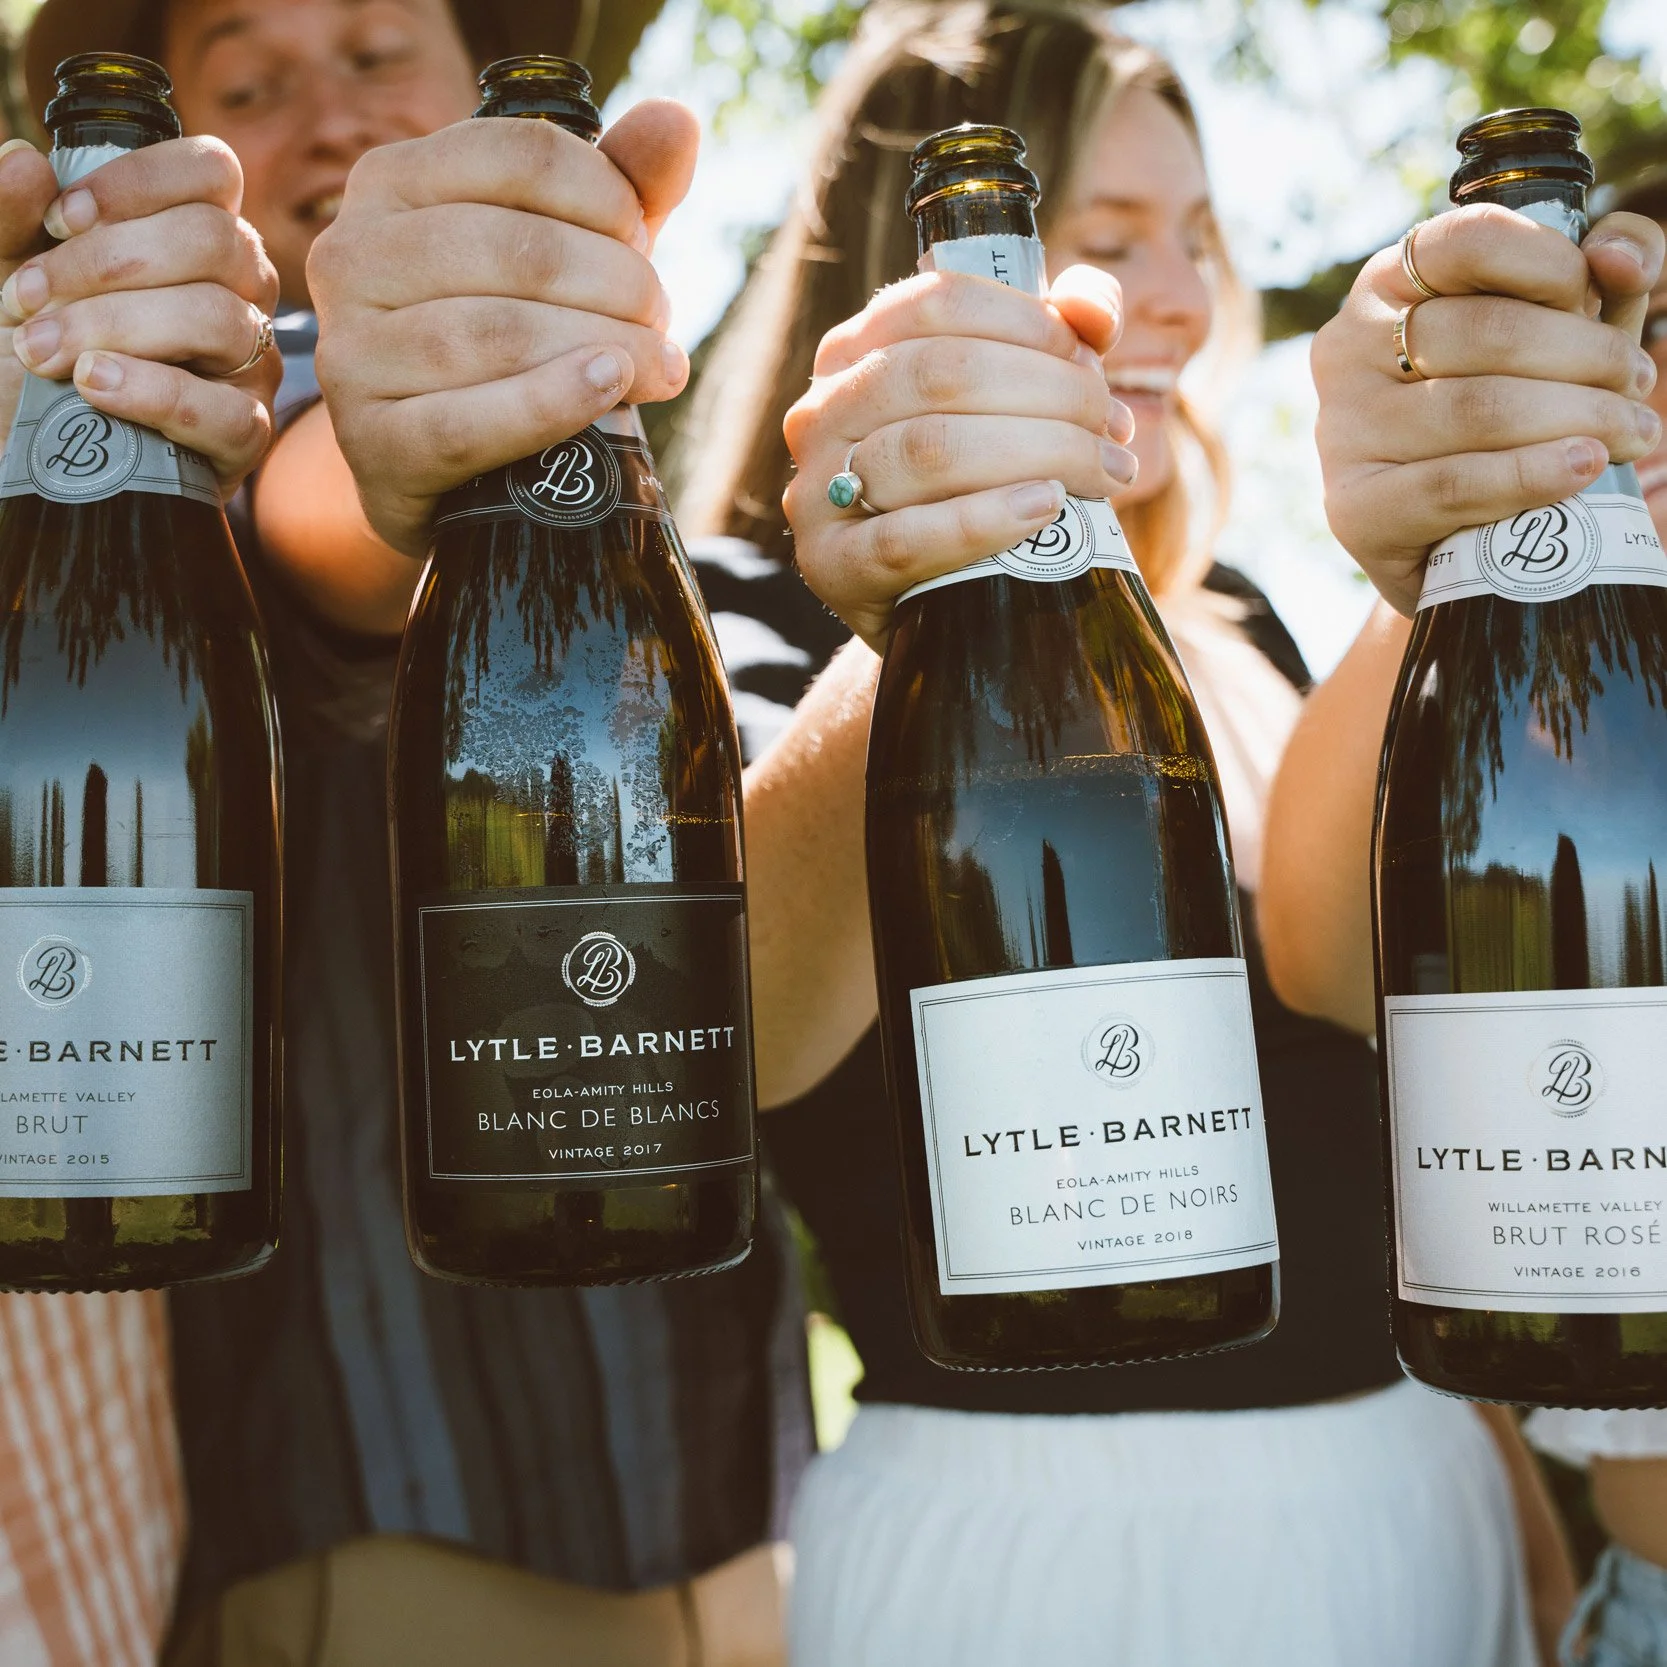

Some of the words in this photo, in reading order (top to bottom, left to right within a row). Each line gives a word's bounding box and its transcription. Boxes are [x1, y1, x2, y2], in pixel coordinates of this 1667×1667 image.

[29, 1040, 218, 1062] BARNETT
[76, 1092, 137, 1103] VALLEY
[532, 1084, 626, 1099] EOLA-AMITY
[632, 1081, 674, 1095] HILLS
[16, 1115, 89, 1134] BRUT
[478, 1110, 567, 1131] BLANC
[582, 1108, 616, 1128] DE
[631, 1100, 720, 1125] BLANCS
[67, 1154, 110, 1165] 2015
[549, 1146, 615, 1160] VINTAGE
[623, 1143, 663, 1156] 2017
[1056, 1170, 1152, 1189] EOLA-AMITY
[1159, 1165, 1200, 1179] HILLS
[1011, 1199, 1106, 1226] BLANC
[1121, 1193, 1156, 1216] DE
[1169, 1184, 1239, 1210] NOIRS
[1488, 1202, 1592, 1214] WILLAMETTE
[1599, 1200, 1663, 1213] VALLEY
[1077, 1235, 1146, 1251] VINTAGE
[1154, 1229, 1194, 1243] 2018
[1493, 1226, 1568, 1246] BRUT
[1585, 1219, 1662, 1246] ROSÉ
[1513, 1266, 1585, 1278] VINTAGE
[1595, 1266, 1642, 1278] 2016
